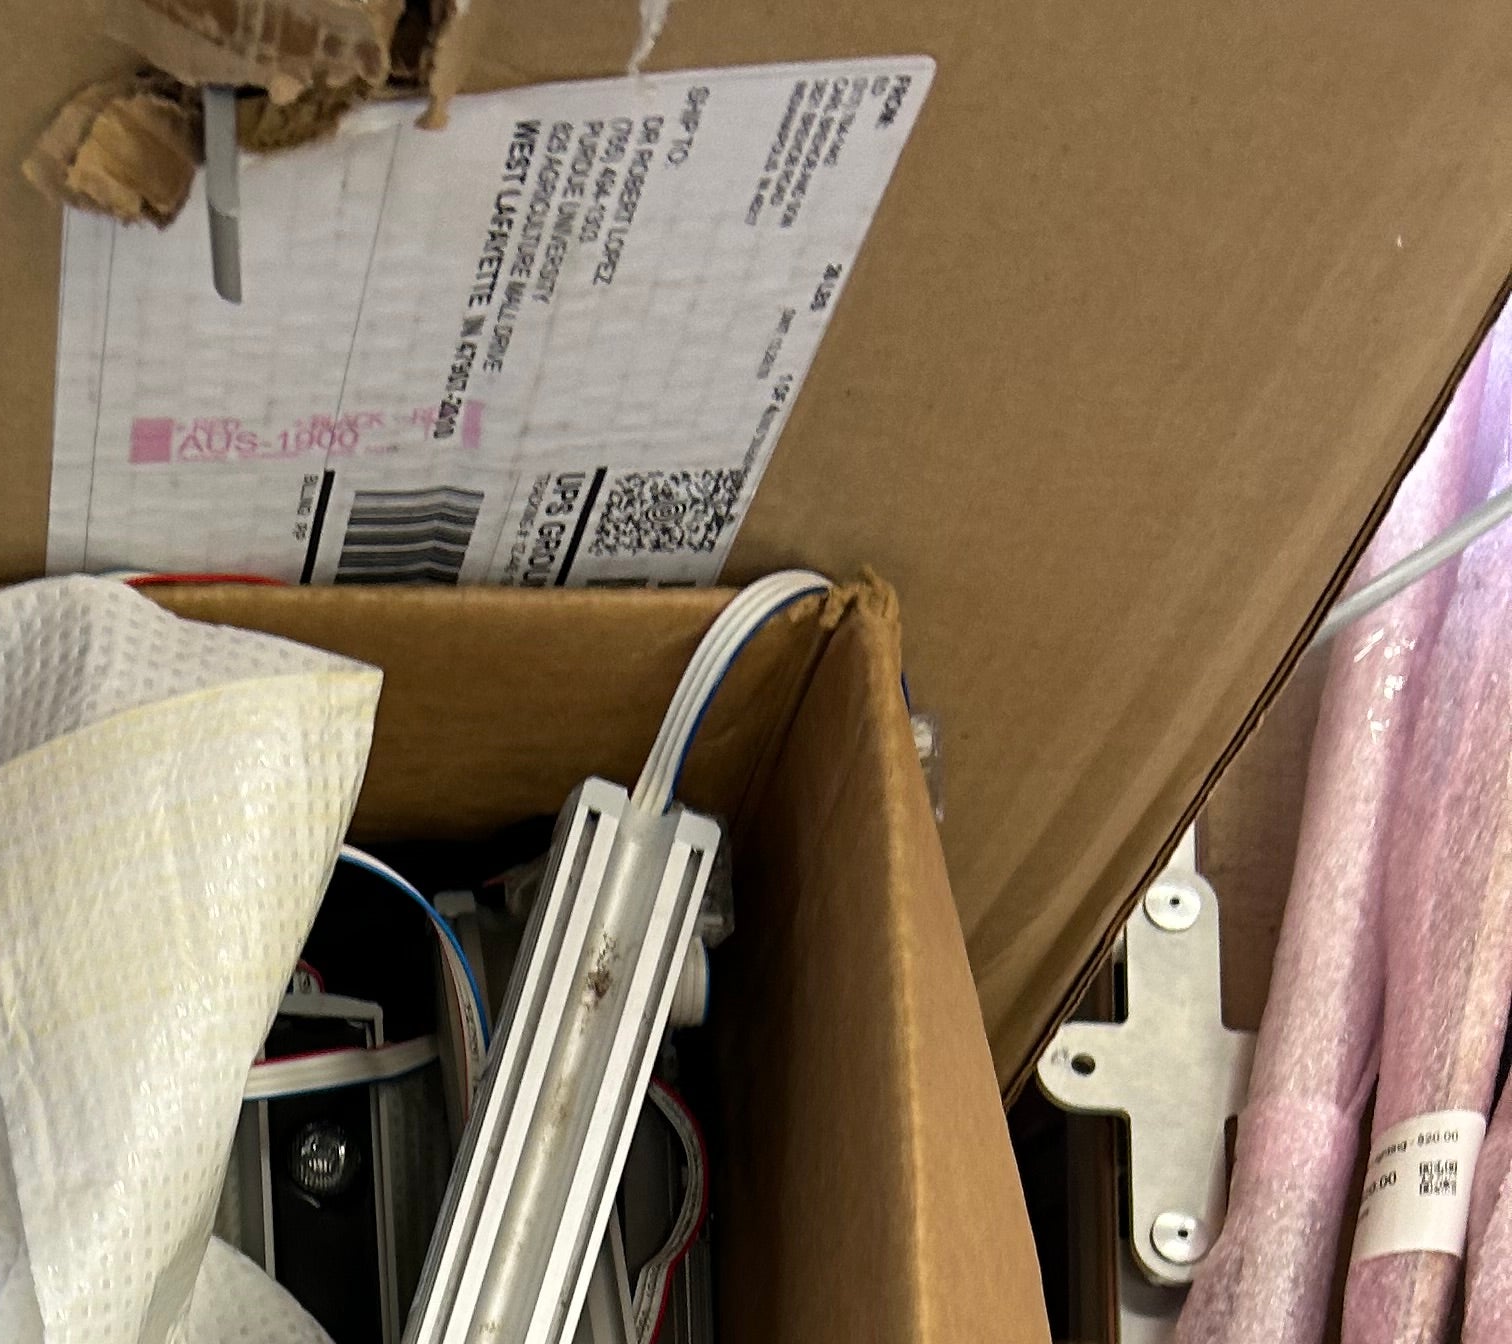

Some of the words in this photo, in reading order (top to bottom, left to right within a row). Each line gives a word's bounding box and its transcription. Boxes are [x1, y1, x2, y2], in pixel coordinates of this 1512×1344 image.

[501, 119, 541, 185] WEST
[468, 187, 522, 309] LAFAYETTE
[546, 471, 586, 516] UPS
